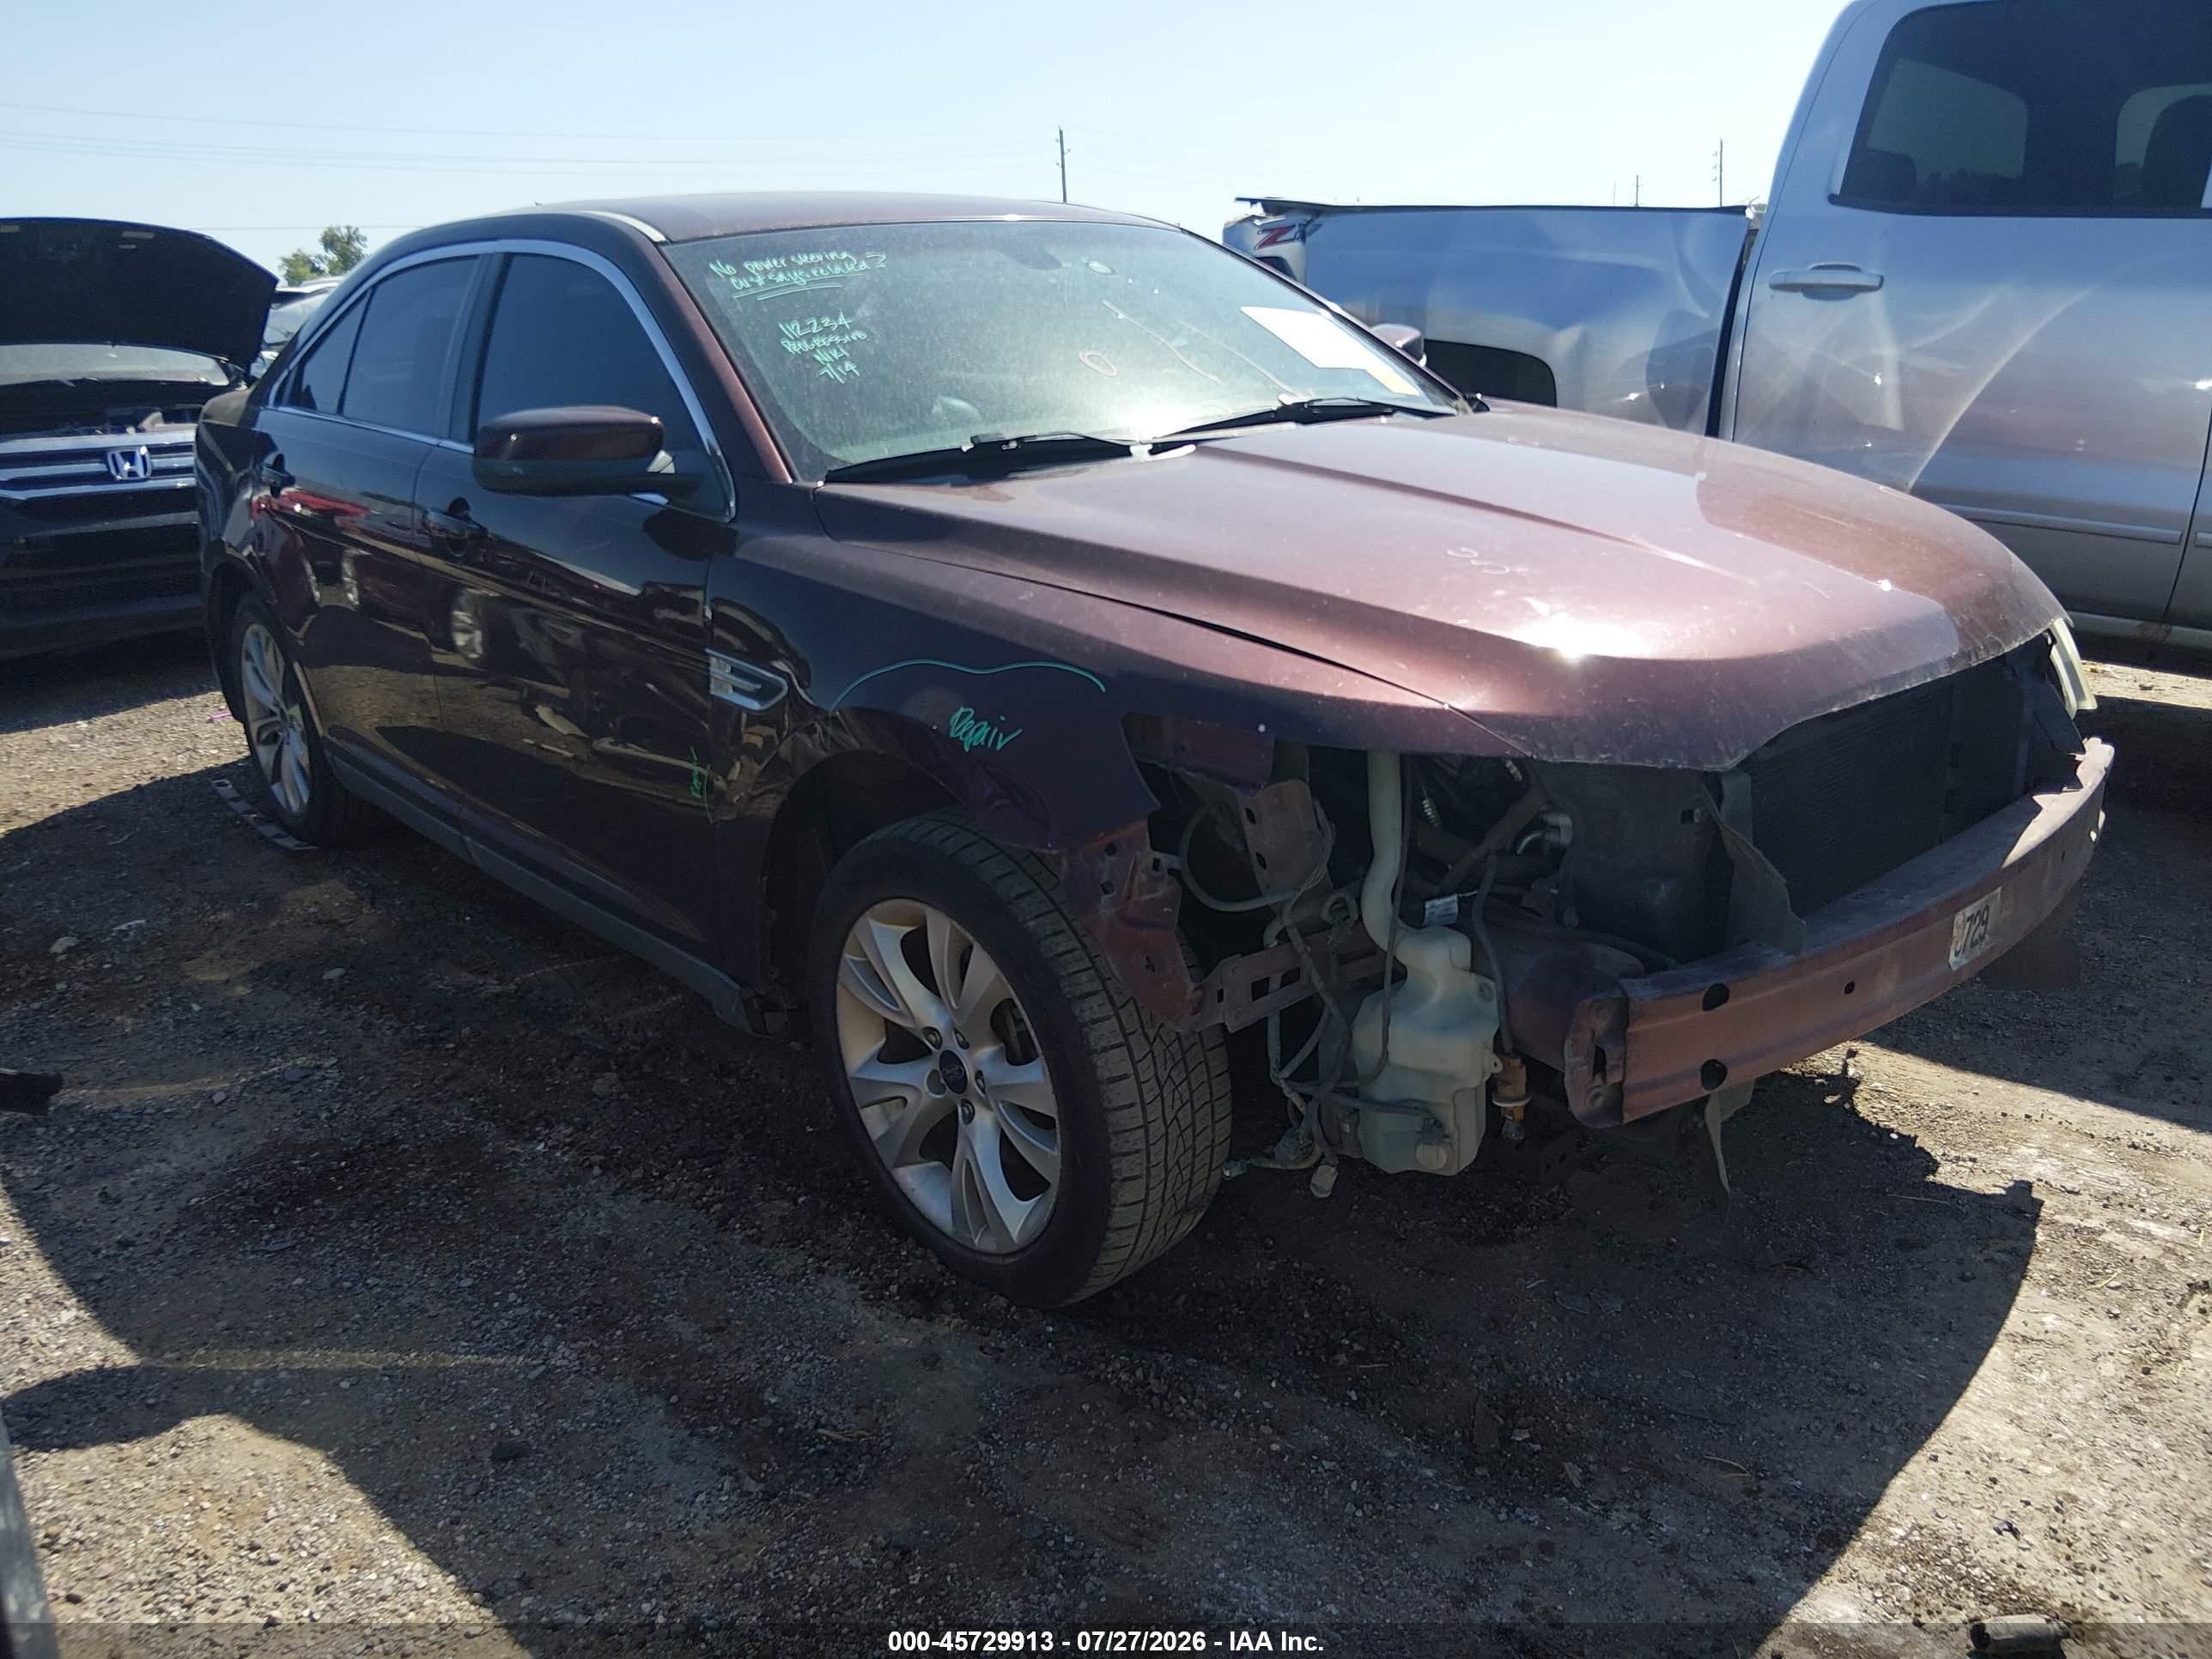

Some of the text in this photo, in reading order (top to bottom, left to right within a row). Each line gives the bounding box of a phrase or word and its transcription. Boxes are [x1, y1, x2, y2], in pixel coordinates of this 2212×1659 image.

[708, 259, 737, 278] No
[743, 256, 787, 275] power
[769, 270, 810, 285] says
[780, 329, 867, 355] PROGRESSIVE
